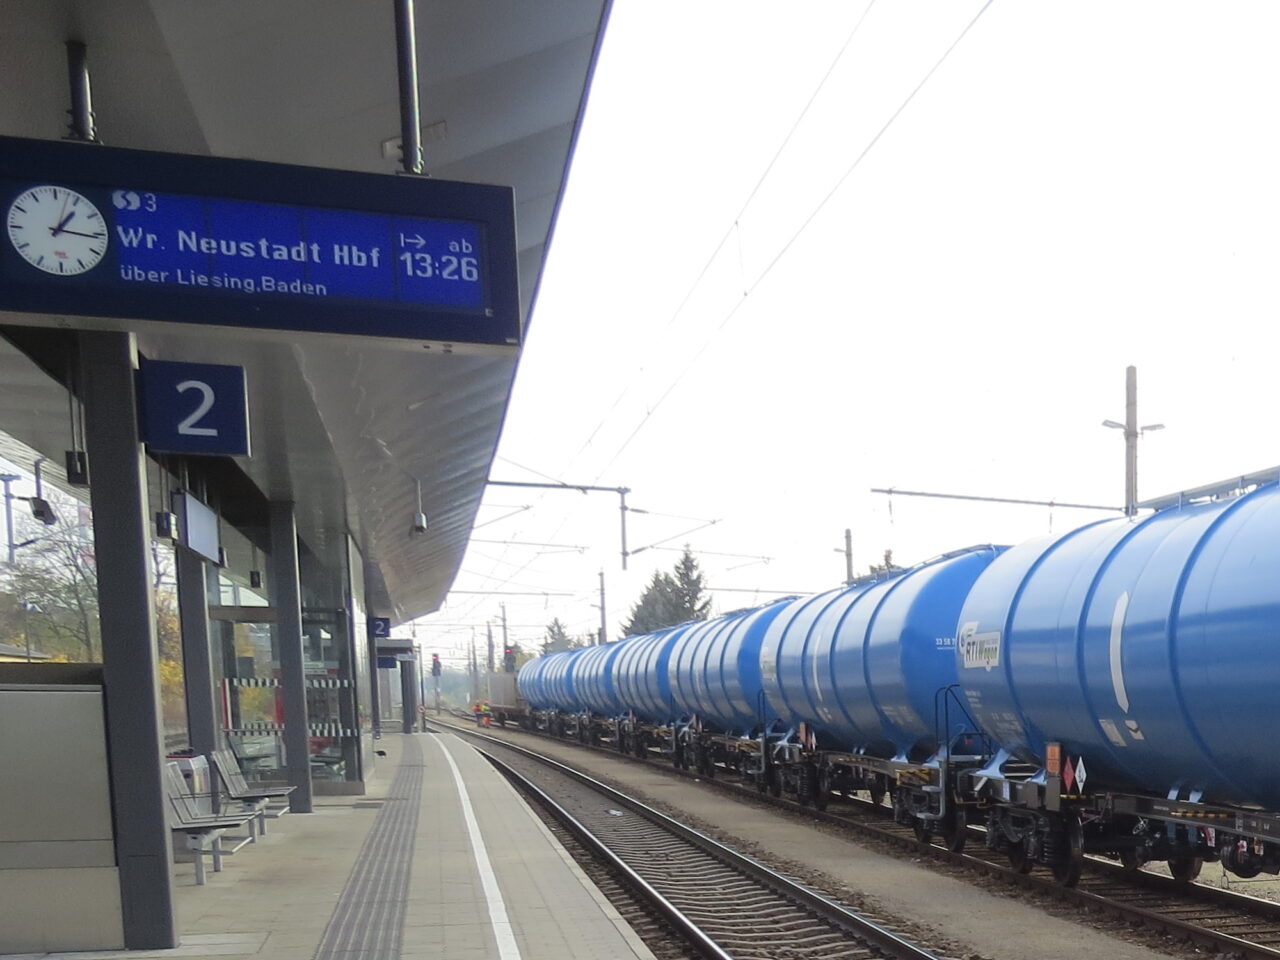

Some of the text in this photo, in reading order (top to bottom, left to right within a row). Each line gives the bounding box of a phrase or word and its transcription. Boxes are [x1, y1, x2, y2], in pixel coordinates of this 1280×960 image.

[144, 193, 157, 212] 3
[117, 225, 380, 268] Wr. Neustadt Hbf
[449, 238, 473, 254] ab
[120, 264, 169, 283] über
[400, 252, 479, 282] 13:26
[176, 379, 218, 437] 2
[375, 621, 386, 635] 2
